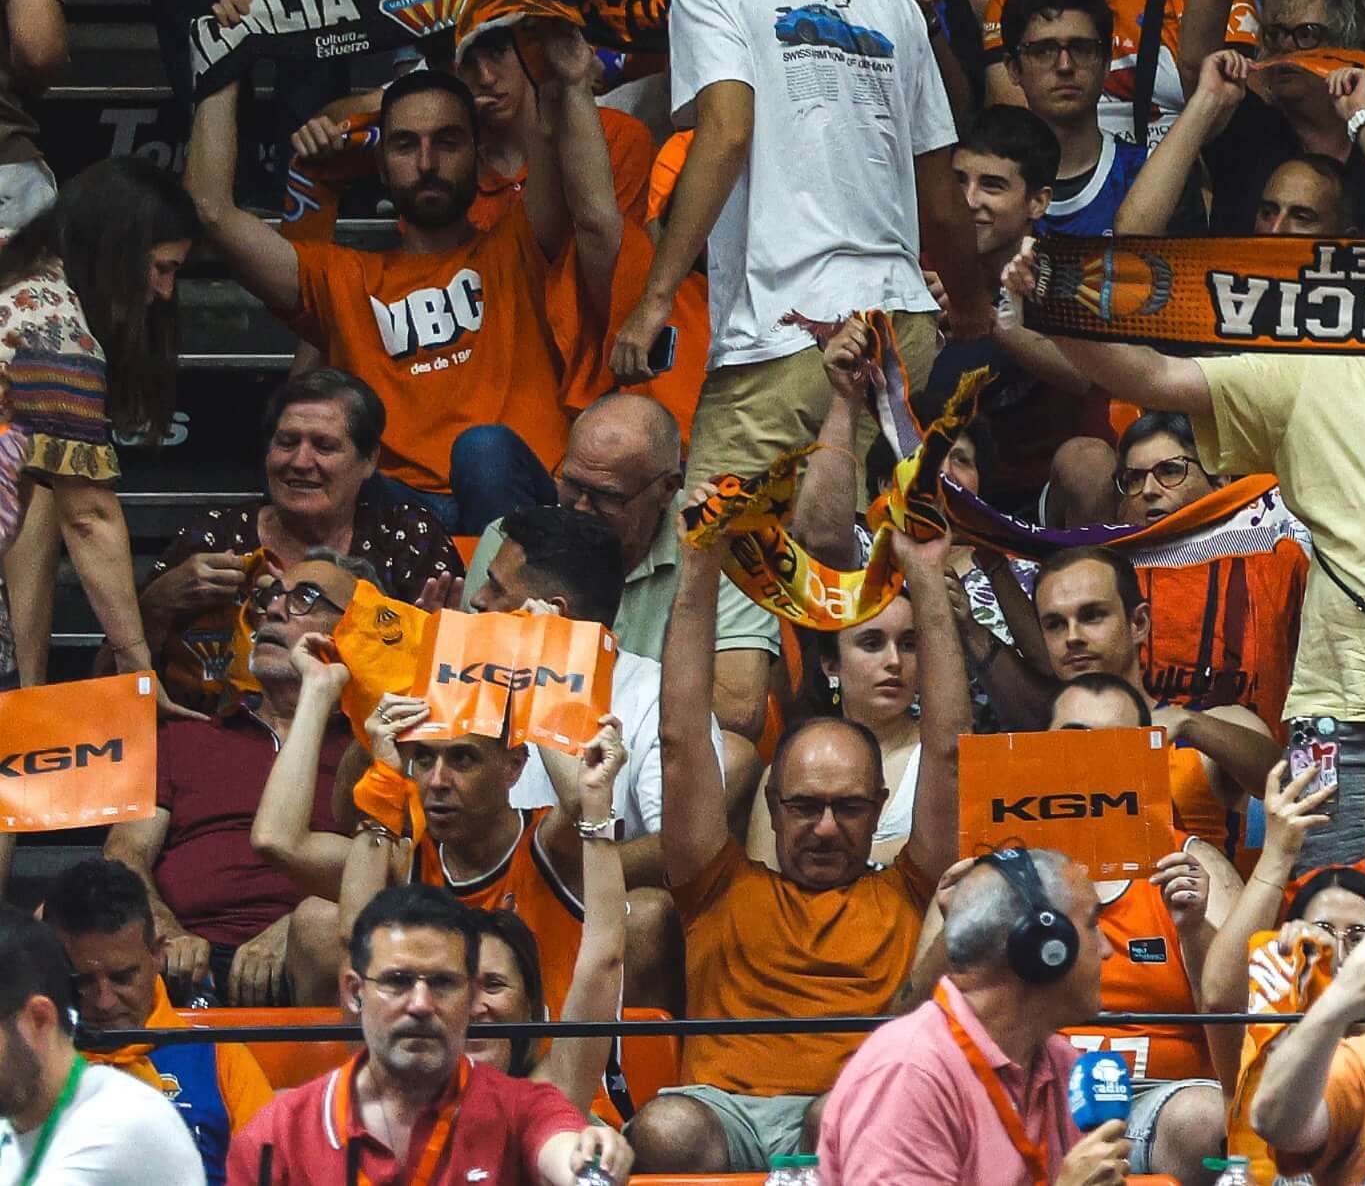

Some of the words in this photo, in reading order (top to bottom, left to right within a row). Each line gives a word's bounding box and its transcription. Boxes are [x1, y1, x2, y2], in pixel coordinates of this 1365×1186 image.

[315, 41, 373, 59] Esfuerzo
[369, 267, 484, 357] VBC
[435, 662, 585, 694] KGM
[0, 739, 124, 778] KGM
[990, 791, 1139, 824] KGM
